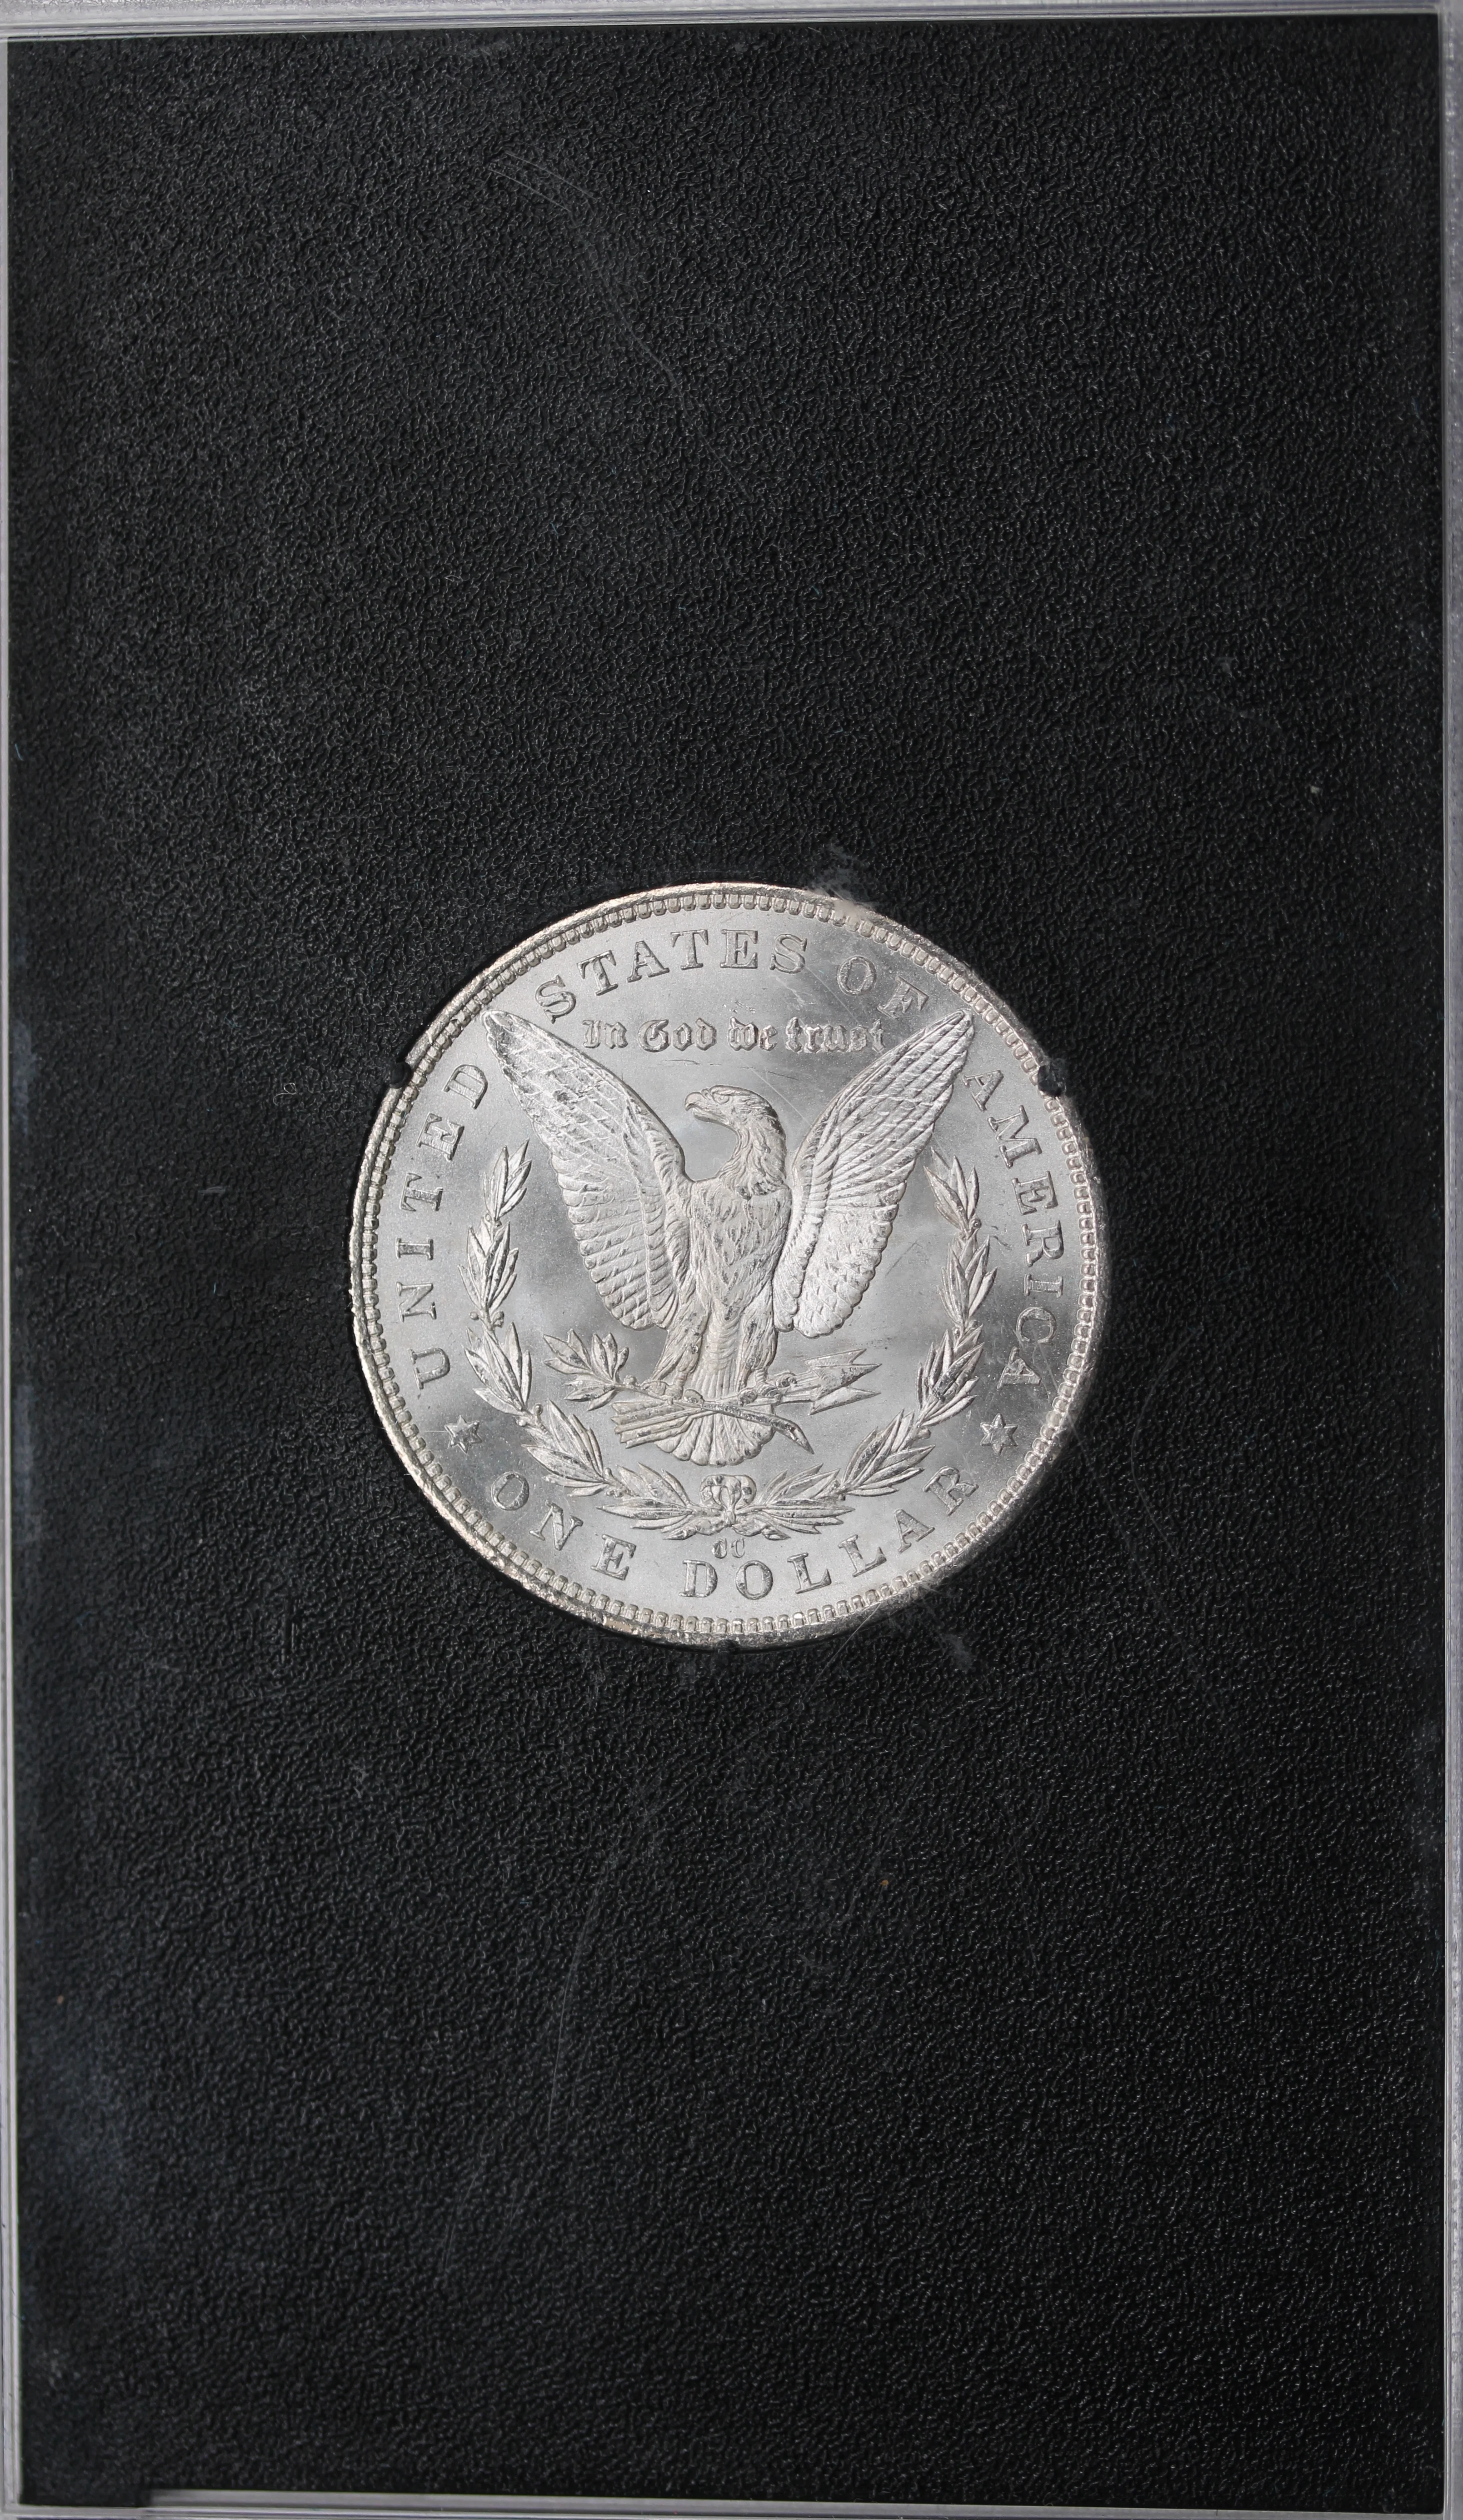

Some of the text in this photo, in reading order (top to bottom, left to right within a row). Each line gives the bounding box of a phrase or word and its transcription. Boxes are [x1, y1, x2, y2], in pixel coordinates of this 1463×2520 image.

[582, 1017, 886, 1053] In God we trust
[396, 929, 1067, 1391] UNITED STATES OF AMERICA
[489, 1464, 979, 1600] ONE DOLLAR
